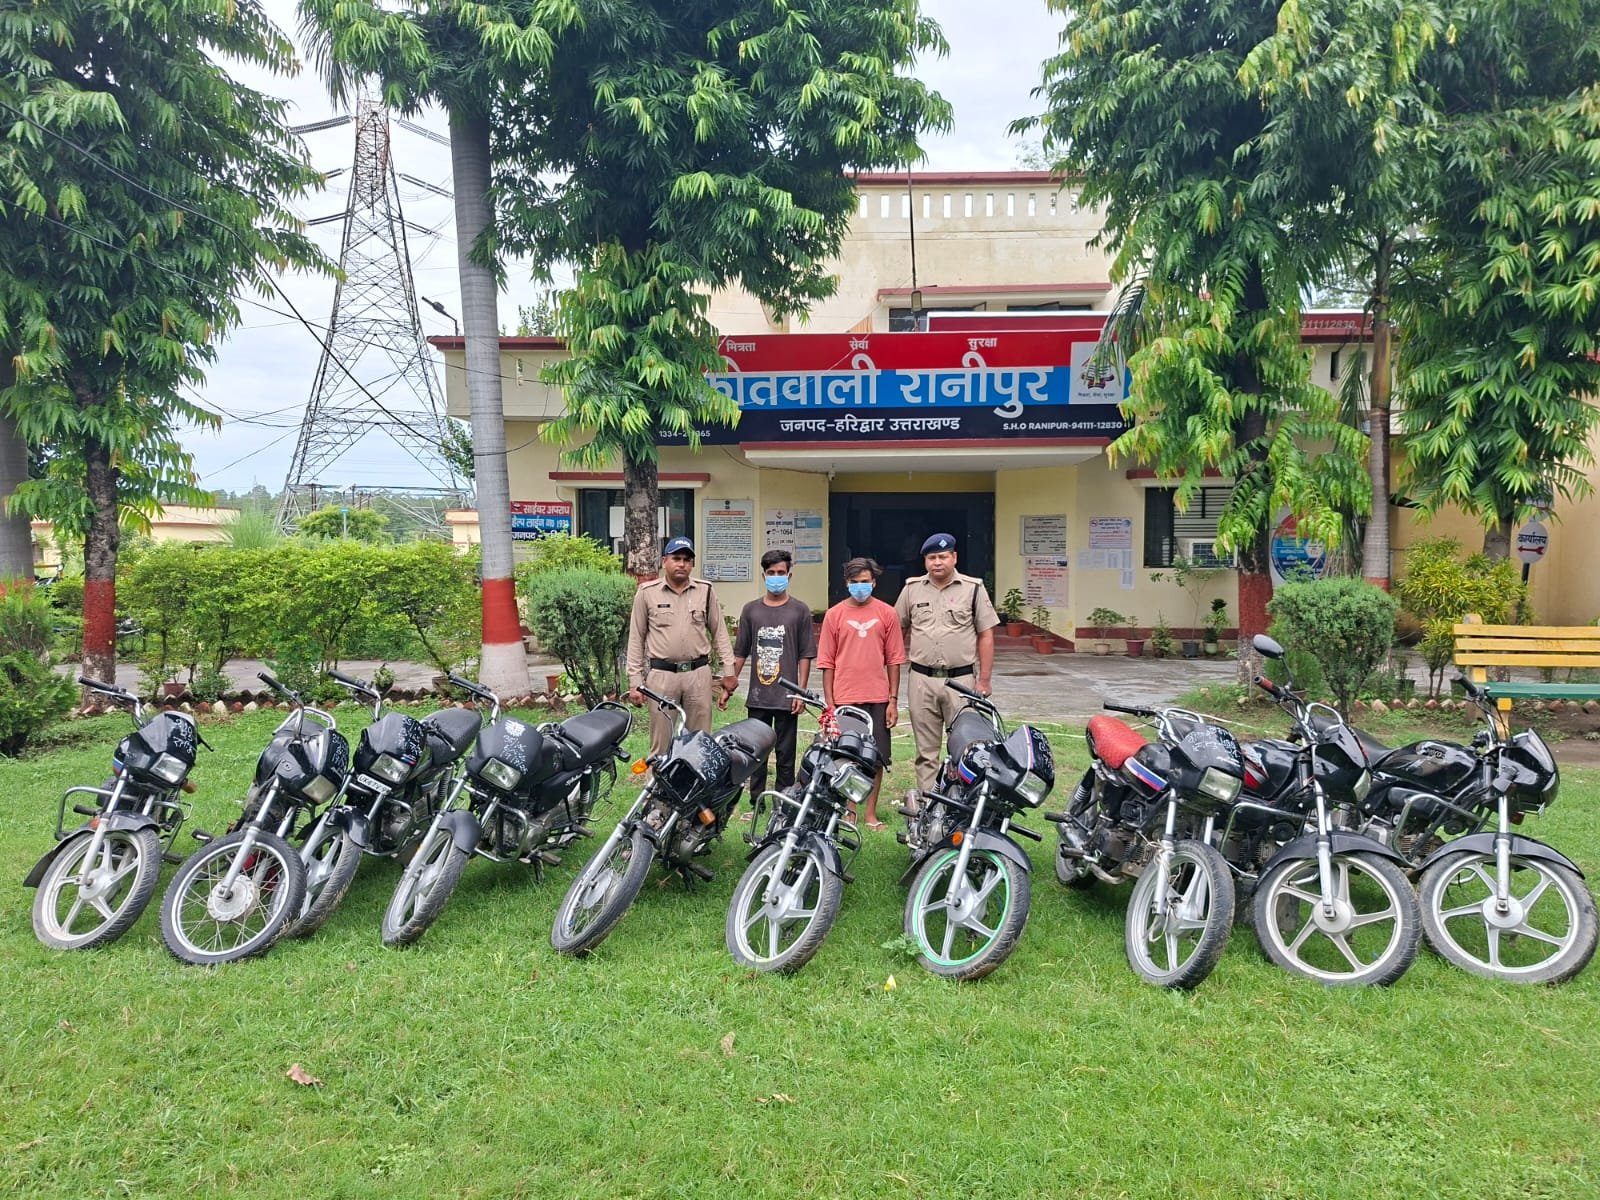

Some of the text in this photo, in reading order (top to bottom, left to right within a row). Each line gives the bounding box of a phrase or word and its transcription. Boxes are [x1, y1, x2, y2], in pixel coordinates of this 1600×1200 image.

[726, 341, 756, 352] मित्रता
[848, 337, 869, 350] सेवा
[967, 337, 998, 350] सुरक्षा
[896, 351, 1054, 419] रानीपुर
[779, 413, 961, 433] जनपद-हरिद्वार उत्तराखण्ड
[1003, 422, 1027, 431] S.H.O
[1518, 531, 1547, 545] कार्यालय
